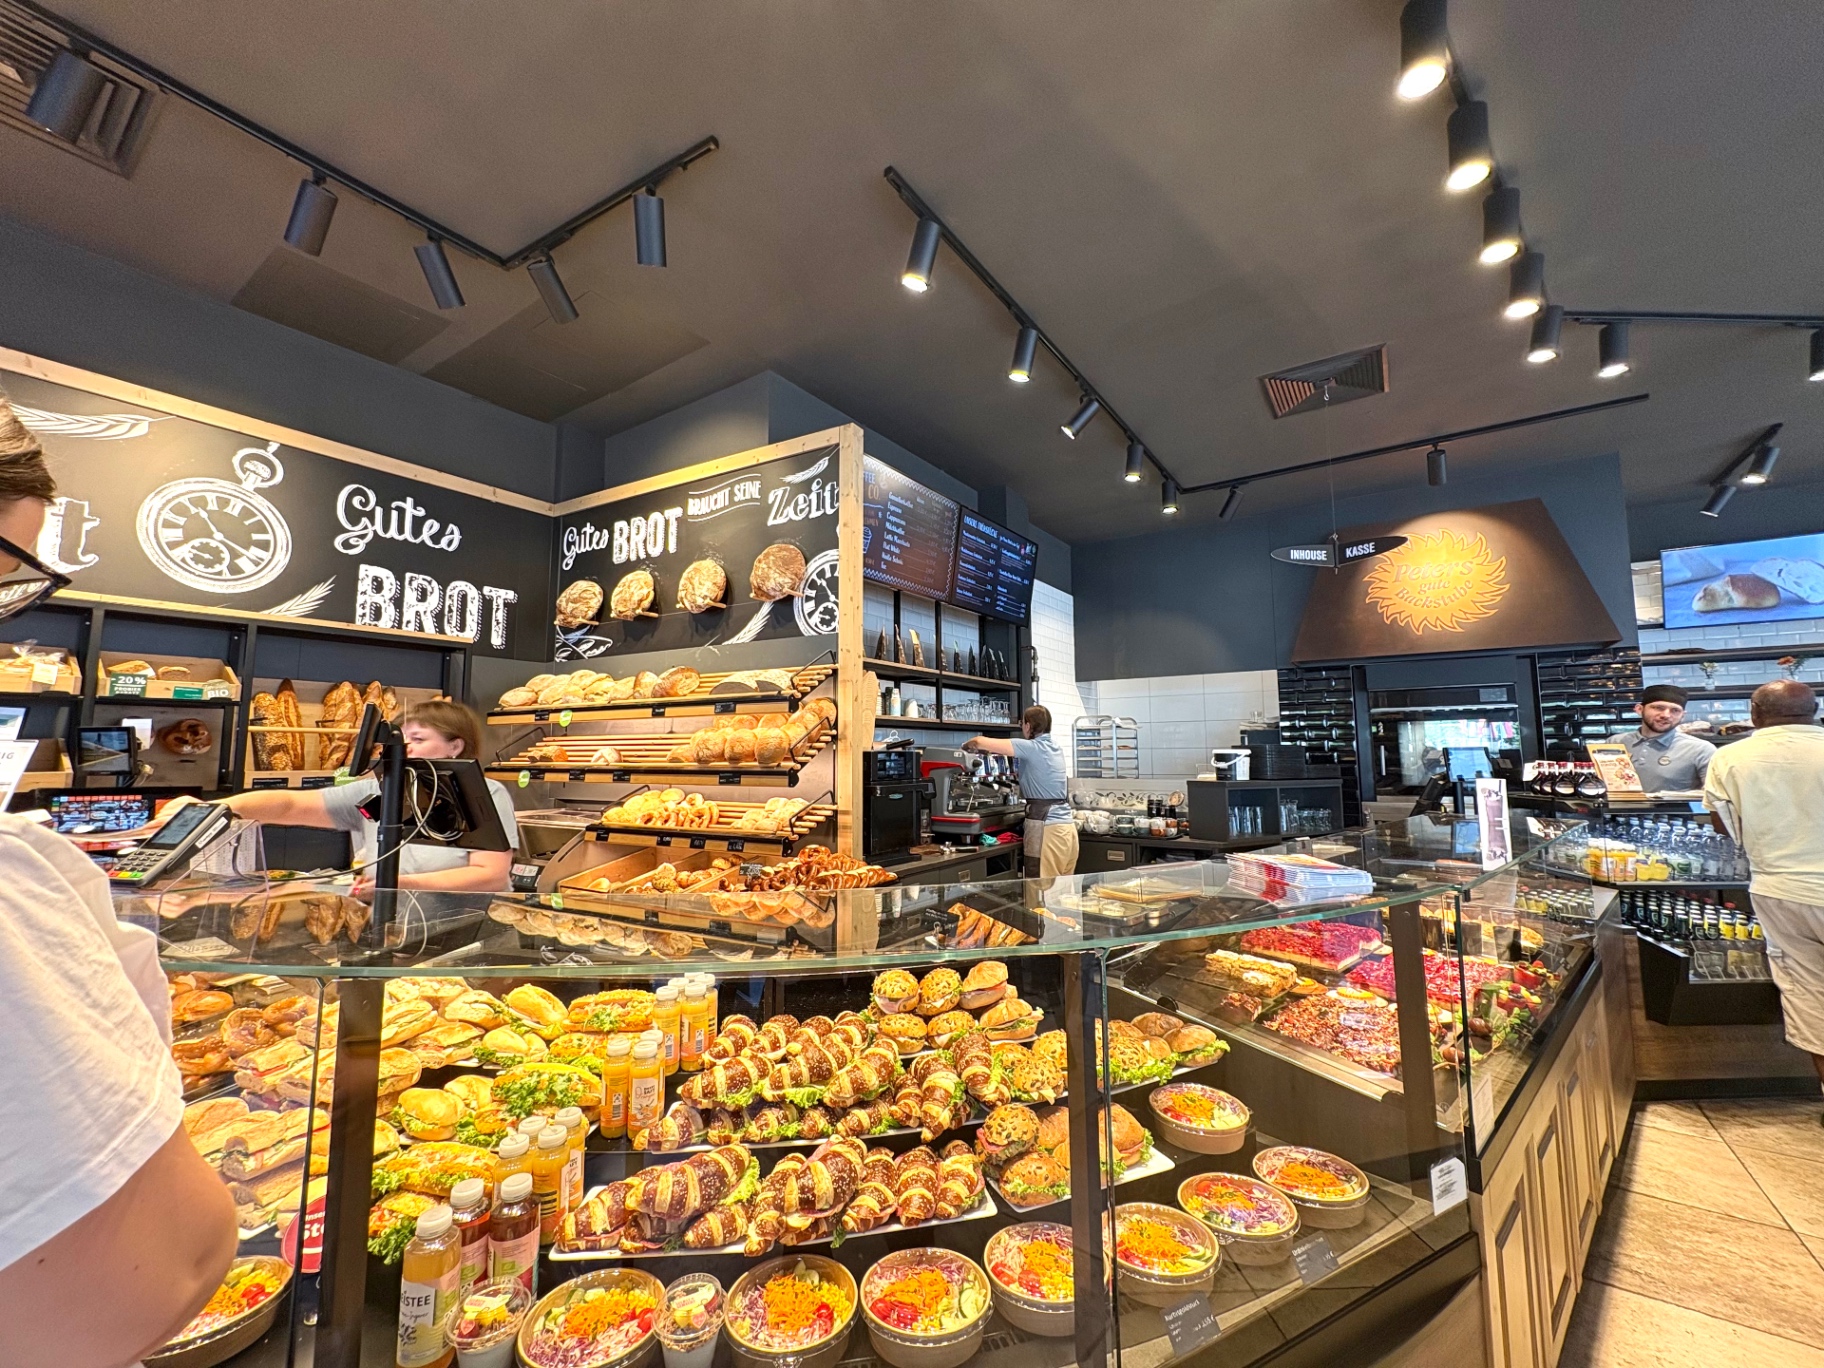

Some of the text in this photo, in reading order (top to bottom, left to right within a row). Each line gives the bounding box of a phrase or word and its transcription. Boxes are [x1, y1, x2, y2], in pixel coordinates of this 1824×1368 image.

[334, 483, 462, 555] Gutes
[562, 478, 839, 571] Gutes BROT BRAUCHT SEINE Zeit
[1290, 542, 1376, 561] INHOUSE KASSE
[1393, 558, 1474, 583] Peters
[1394, 579, 1474, 608] Backstube
[1419, 580, 1451, 594] gute
[355, 563, 519, 650] BROT
[207, 689, 229, 698] BIO
